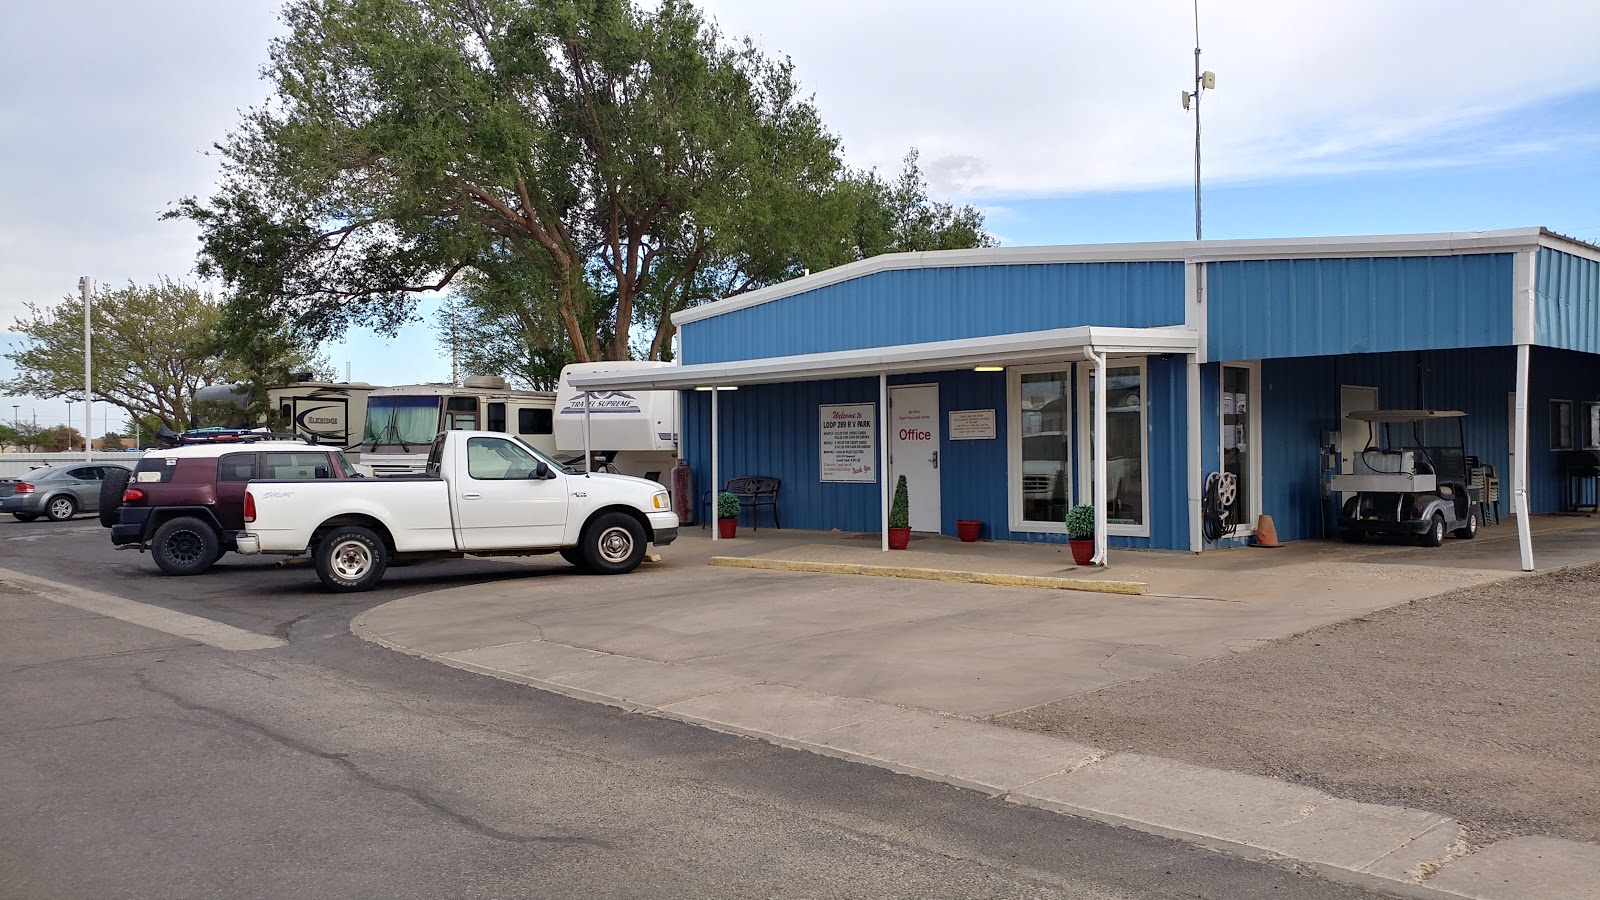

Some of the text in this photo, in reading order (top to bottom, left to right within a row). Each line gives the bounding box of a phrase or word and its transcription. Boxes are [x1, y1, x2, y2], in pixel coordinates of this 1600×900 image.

[308, 416, 338, 424] ELKRIDGE
[832, 411, 856, 420] Welcome
[823, 421, 836, 429] LOOP
[848, 420, 852, 428] R
[853, 420, 857, 428] V
[857, 420, 871, 428] PARK
[899, 429, 931, 441] Office
[852, 467, 862, 475] Thank
[863, 464, 871, 474] You
